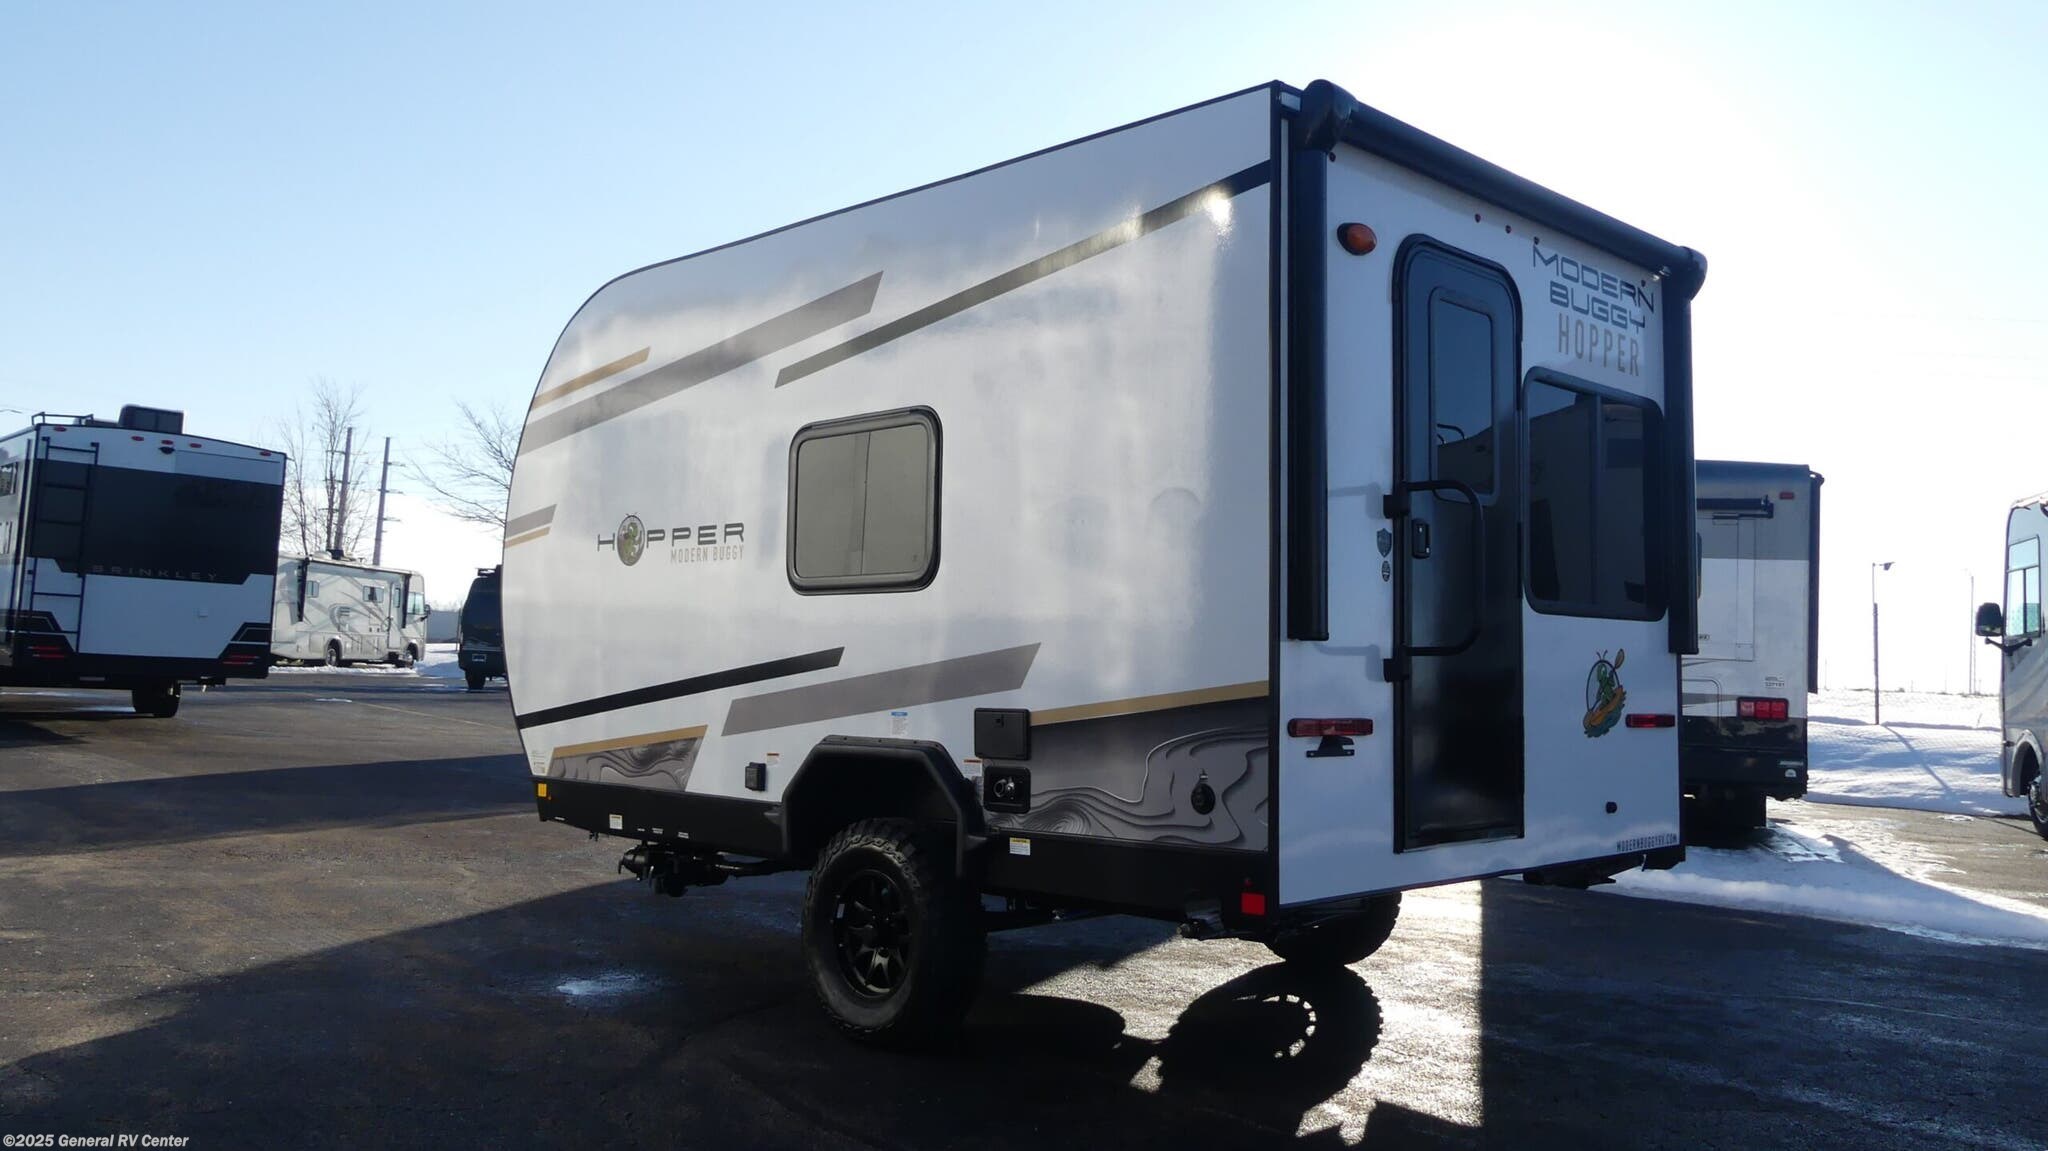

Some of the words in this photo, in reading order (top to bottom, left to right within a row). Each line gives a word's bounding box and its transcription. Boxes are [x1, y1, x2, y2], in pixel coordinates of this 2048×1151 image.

[1533, 243, 1655, 314] MODERN
[1550, 280, 1646, 334] BUGGY
[1558, 312, 1640, 377] HOPPER
[93, 564, 218, 582] BRINKLEY
[670, 547, 709, 564] MODERN
[713, 545, 745, 561] BUGGY
